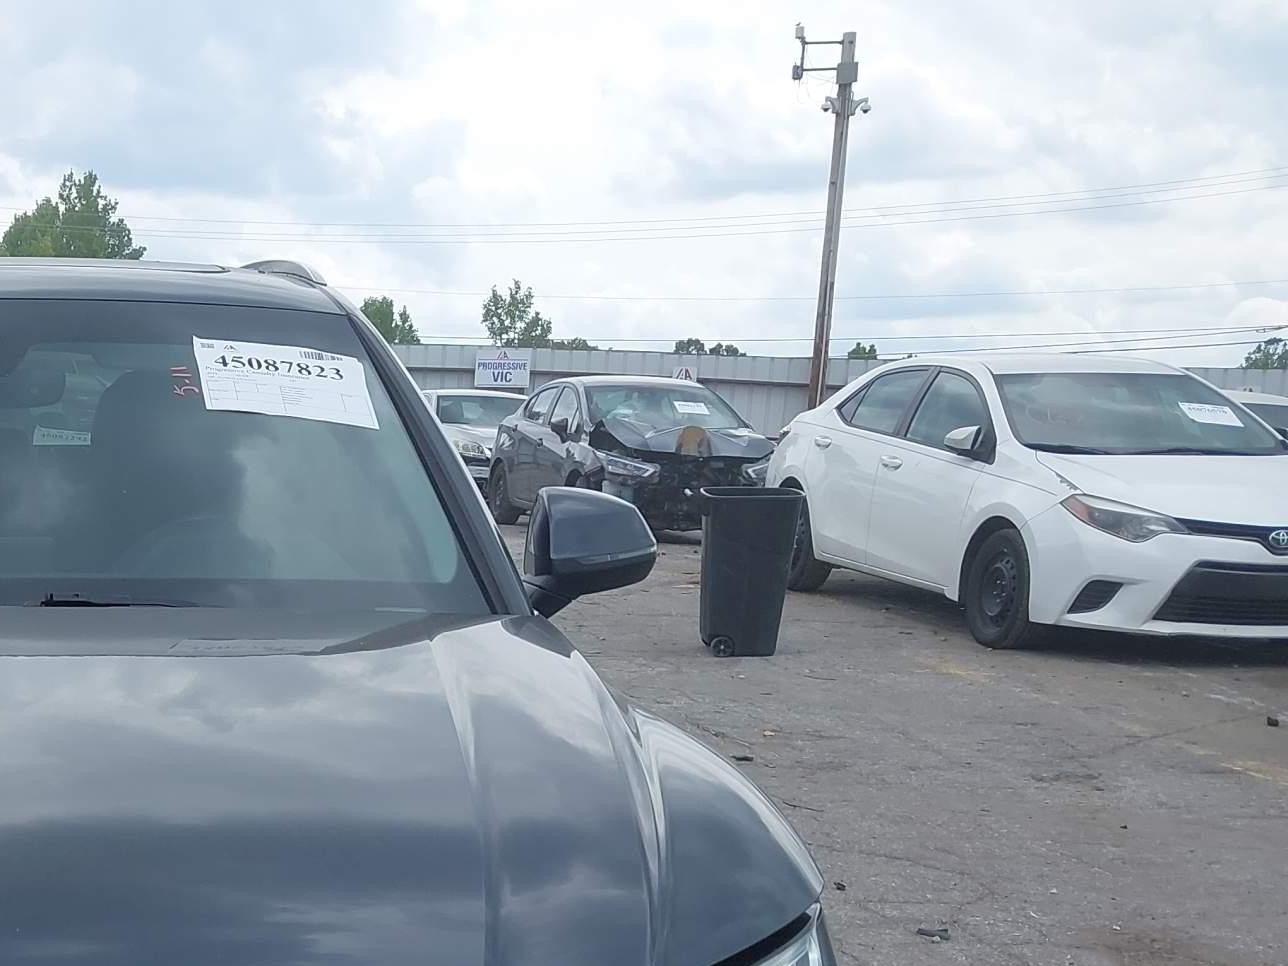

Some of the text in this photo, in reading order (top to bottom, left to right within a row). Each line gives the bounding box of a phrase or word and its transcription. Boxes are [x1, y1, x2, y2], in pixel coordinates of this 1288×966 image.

[214, 354, 344, 381] 45087823
[477, 361, 528, 371] PROGRESSIVE
[491, 371, 513, 383] VIC
